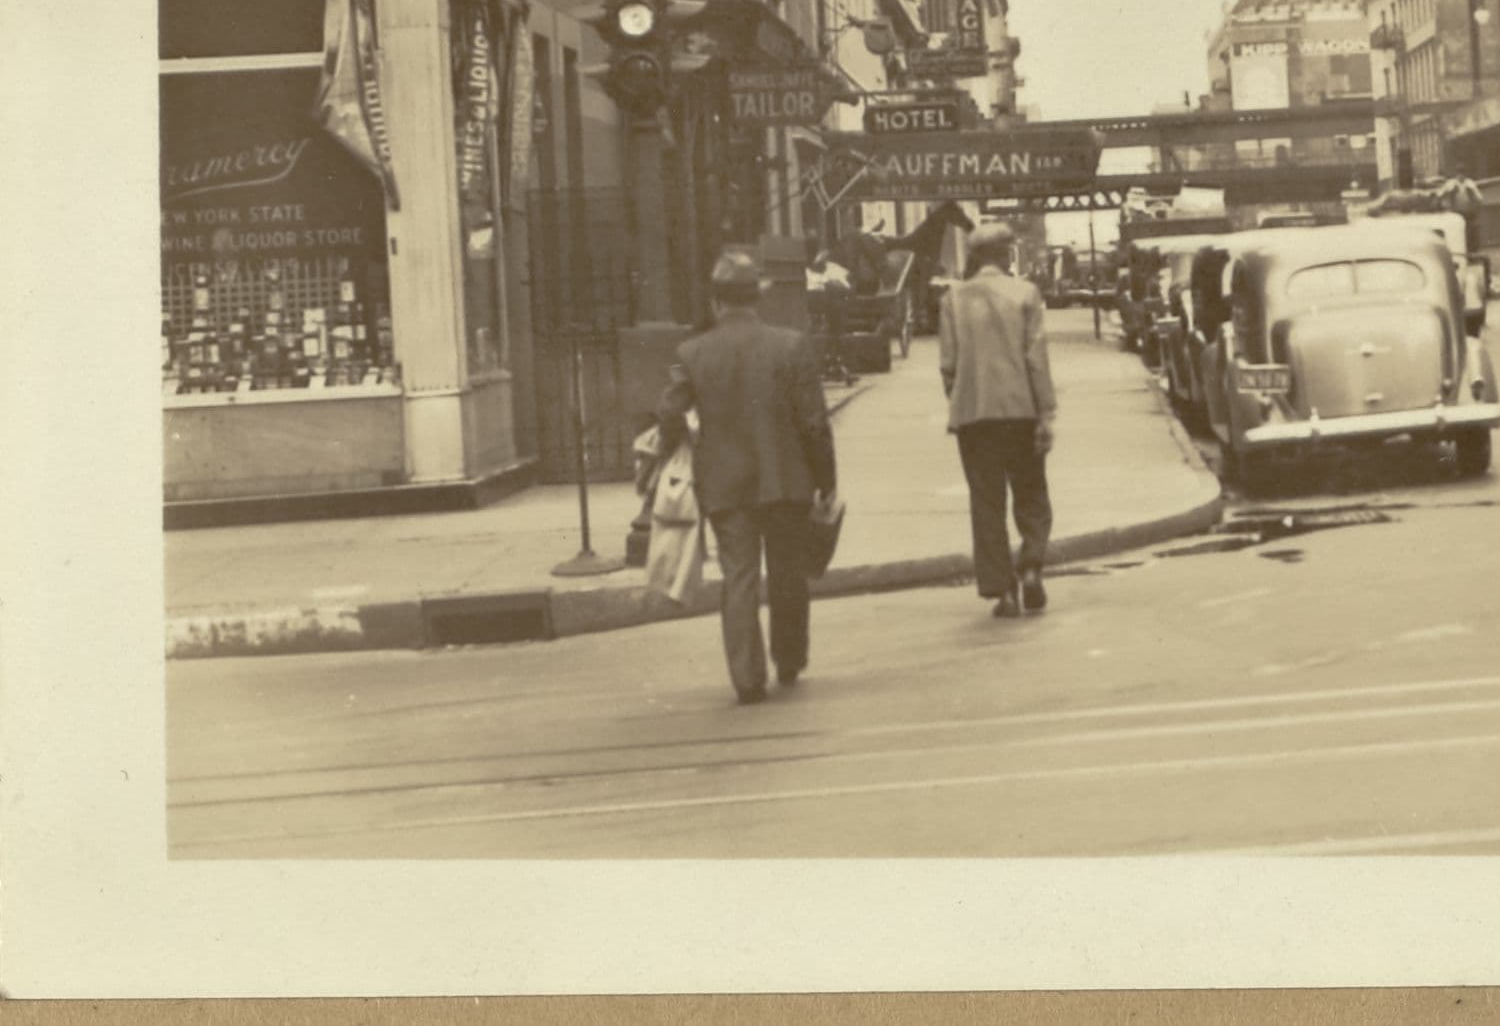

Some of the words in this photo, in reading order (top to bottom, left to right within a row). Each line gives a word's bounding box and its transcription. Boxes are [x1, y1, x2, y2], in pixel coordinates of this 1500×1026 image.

[731, 92, 815, 119] TAILOR
[875, 109, 952, 129] HOTEL
[194, 209, 242, 224] YORK
[249, 204, 304, 223] STATE
[161, 236, 206, 252] WINE
[230, 230, 298, 251] LIQUOR
[303, 227, 363, 247] STORE
